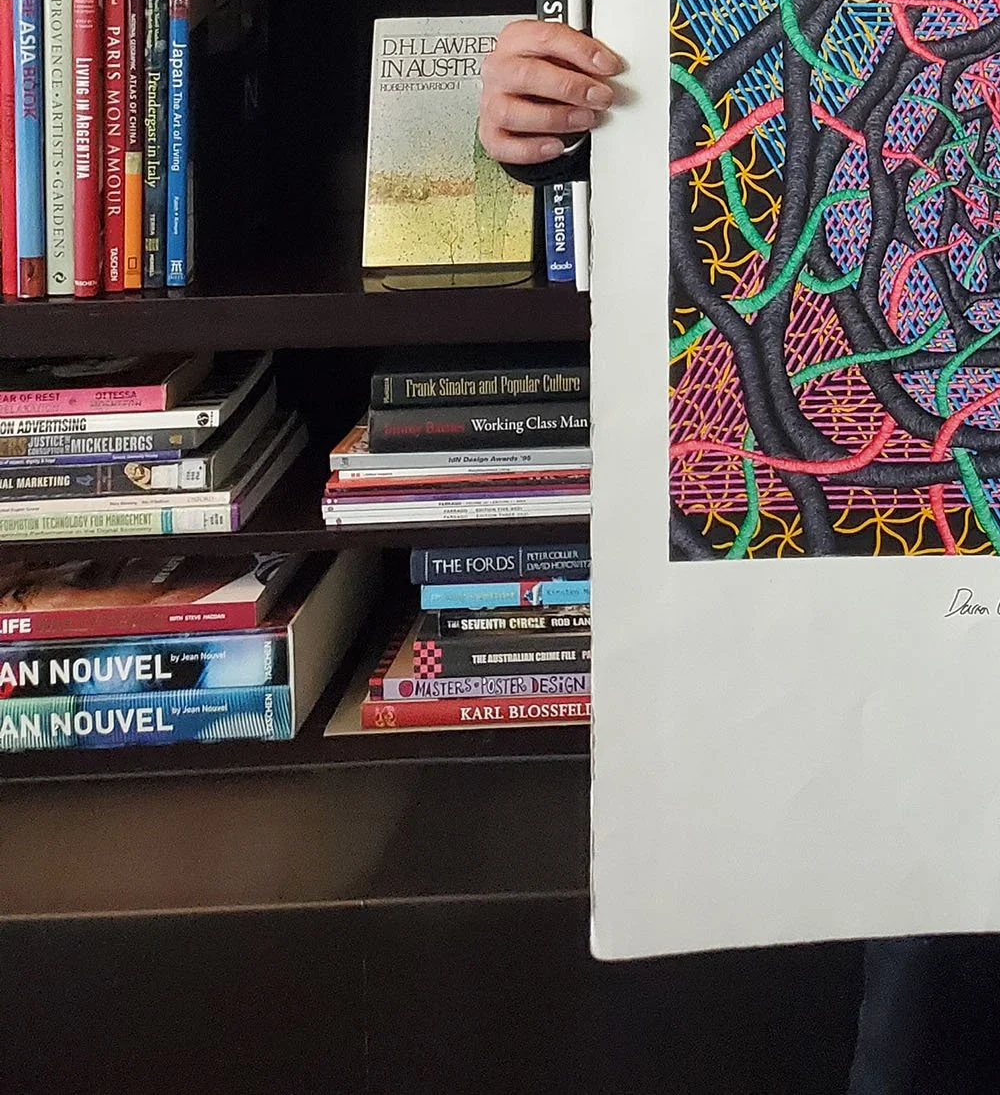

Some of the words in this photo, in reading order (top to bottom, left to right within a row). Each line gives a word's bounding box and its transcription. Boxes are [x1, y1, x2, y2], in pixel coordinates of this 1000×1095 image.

[20, 20, 36, 64] ASIA
[107, 26, 120, 80] PARIS
[170, 41, 187, 88] Japan
[381, 59, 403, 77] IN
[406, 57, 481, 78] AUSTR
[76, 57, 93, 94] LIVING
[23, 66, 37, 120] BOOK
[173, 92, 182, 110] The
[107, 90, 121, 136] MON
[130, 103, 137, 113] OF
[145, 72, 160, 141] Prendergast
[173, 113, 182, 127] Art
[51, 99, 63, 167] ARTISTS
[76, 114, 93, 179] ARGENTINA
[171, 143, 182, 171] Living
[107, 146, 121, 216] AMOUR
[145, 161, 160, 188] Italy
[52, 178, 65, 258] GARDENS
[554, 207, 566, 252] DESIGN
[95, 391, 137, 400] OTTESSA
[406, 378, 437, 398] Frank
[439, 378, 476, 397] Sinatra
[479, 378, 497, 395] and
[501, 375, 540, 396] Popular
[542, 374, 580, 393] Culture
[19, 393, 33, 402] OF
[35, 392, 60, 402] REST
[17, 418, 87, 434] ADVERTISING
[471, 418, 524, 435] Working
[526, 416, 557, 430] Class
[560, 415, 589, 428] Man
[28, 435, 64, 448] JUSTICE
[71, 436, 153, 453] MICKELBERGS
[464, 456, 489, 464] Design
[17, 475, 71, 490] MARKETING
[432, 559, 463, 574] THE
[466, 556, 515, 572] FORDS
[461, 619, 507, 630] SEVENTH
[509, 617, 546, 629] CIRCLE
[551, 618, 571, 627] ROB
[170, 654, 181, 662] by
[182, 652, 199, 661] Jean
[201, 651, 226, 660] Nouvel
[472, 655, 487, 664] THE
[487, 653, 535, 663] AUSTRALIAN
[535, 652, 560, 662] CRIME
[561, 650, 576, 661] FILE
[50, 654, 172, 685] NOUVEL
[414, 679, 472, 696] MASTERS
[481, 677, 527, 695] POSTER
[531, 675, 586, 693] DESIGN
[182, 705, 200, 714] Jean
[202, 704, 228, 713] Nouvel
[460, 707, 504, 721] KARL
[51, 708, 174, 737] NOUVEL
